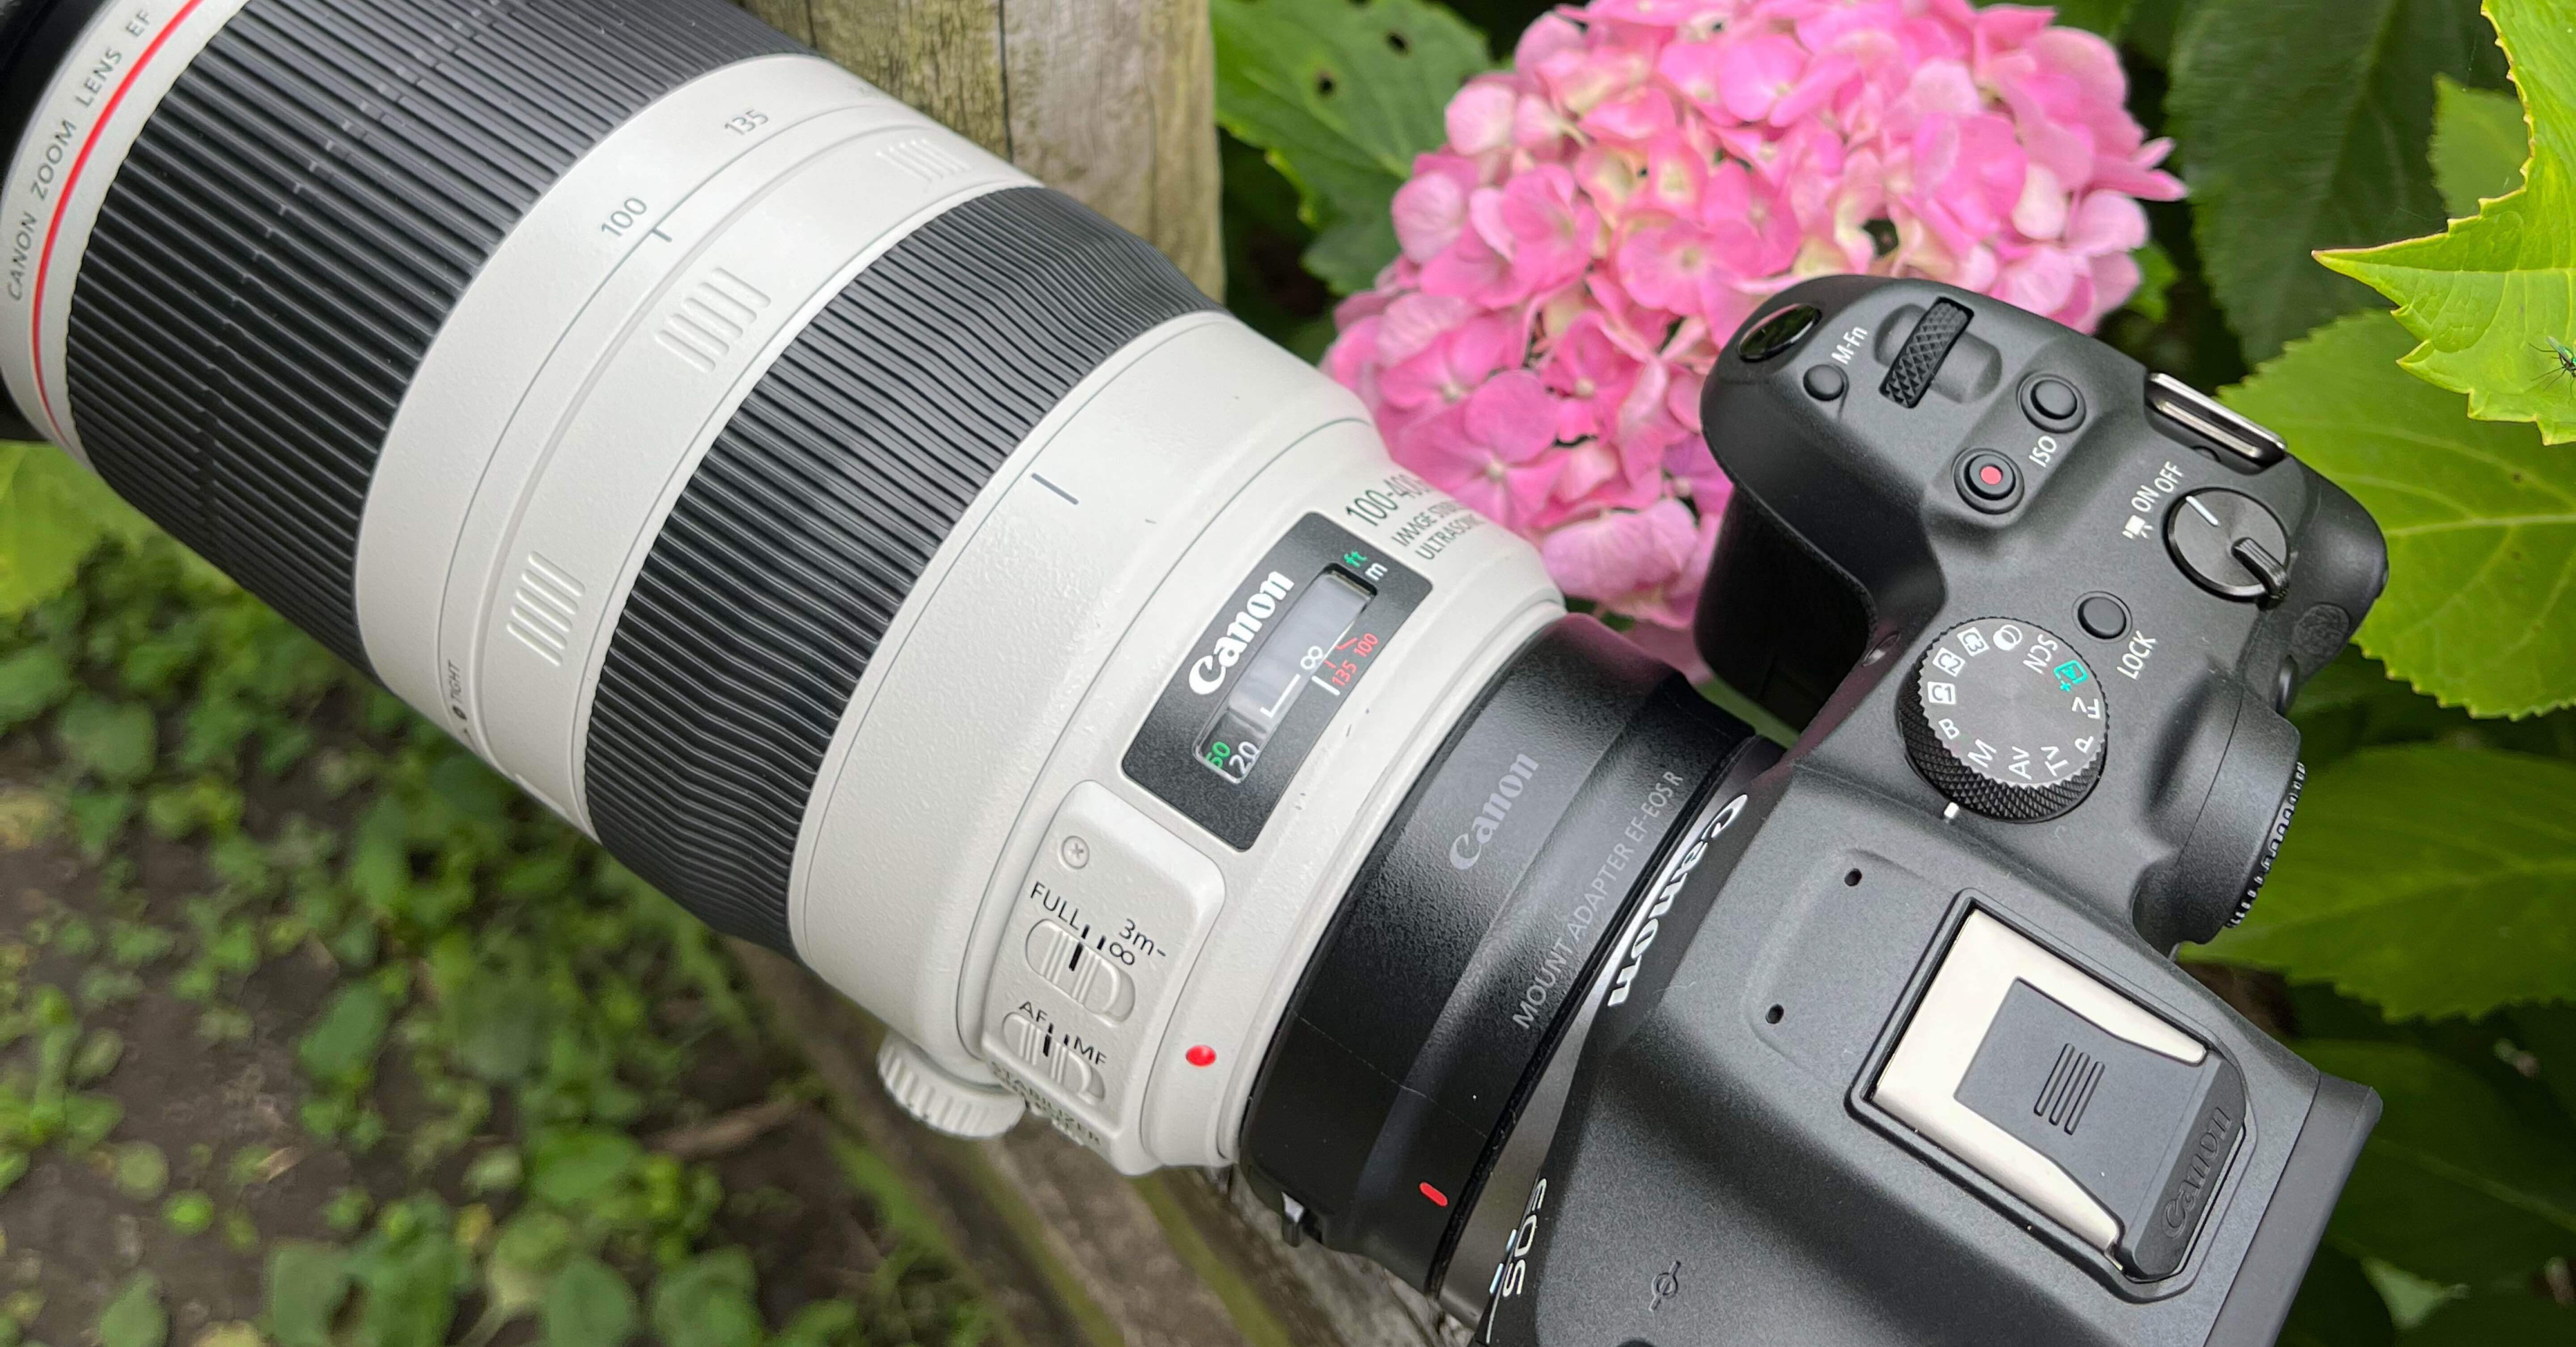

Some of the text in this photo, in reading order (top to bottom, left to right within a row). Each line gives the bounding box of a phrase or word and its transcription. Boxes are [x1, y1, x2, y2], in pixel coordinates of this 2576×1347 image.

[724, 108, 769, 136] 135
[7, 10, 153, 300] CANON ZOOM LENS EF
[601, 197, 647, 238] 100
[1831, 326, 1868, 366] M-Fn
[2029, 435, 2057, 468] ISO
[2154, 461, 2184, 493] OFF
[2131, 485, 2159, 513] ON
[1391, 512, 1437, 546] IMAGE
[1343, 551, 1367, 567] ft
[1365, 562, 1388, 580] m
[1189, 571, 1295, 695] Canon
[1354, 633, 1378, 657] 100
[2023, 634, 2058, 674] SCN
[2117, 630, 2157, 680] LOCK
[1332, 660, 1357, 686] 135
[1938, 718, 1960, 739] B
[2075, 736, 2093, 753] P
[1205, 741, 1230, 769] 50
[1229, 741, 1260, 774] 20
[1967, 739, 1996, 768] M
[1449, 754, 1539, 870] Canon
[1030, 881, 1079, 930] FULL
[1513, 770, 1683, 1028] MOUNT ADAPTER EF-EOS R
[1607, 794, 1748, 1006] Canon
[1019, 1001, 1047, 1023] AF
[1074, 1036, 1107, 1066] MF
[2162, 1107, 2233, 1238] Canon
[1503, 1178, 1546, 1297] EOS
